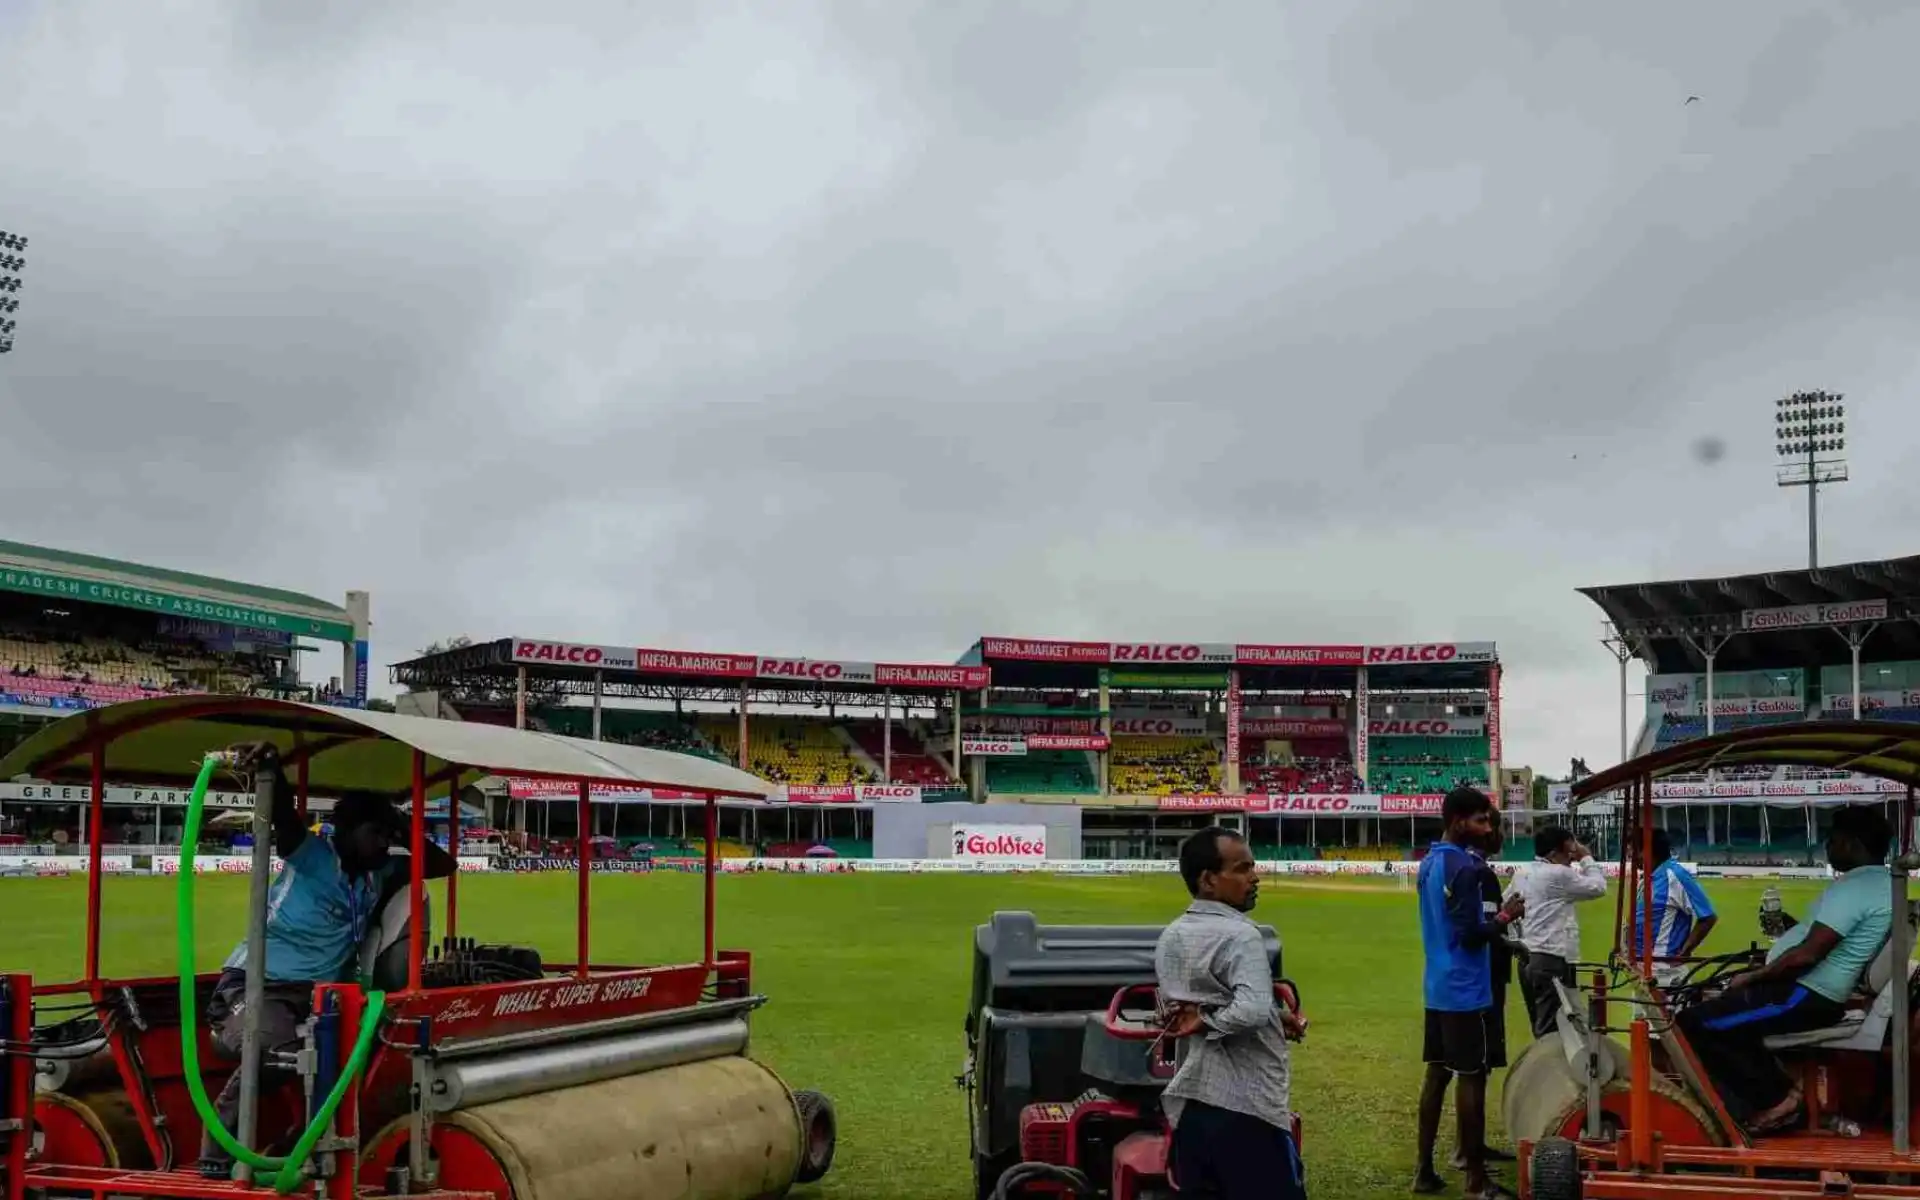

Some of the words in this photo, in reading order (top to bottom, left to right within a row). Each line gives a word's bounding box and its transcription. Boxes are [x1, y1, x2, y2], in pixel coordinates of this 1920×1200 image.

[0, 573, 79, 593] RADESH
[90, 584, 164, 608] CRICKET
[174, 598, 277, 625] ASSOCIATION
[516, 643, 604, 664] RALCO
[987, 641, 1070, 658] INFRA.MARKET
[1113, 645, 1200, 661] RALCO
[1237, 647, 1321, 662] INFRA.MARKET
[1366, 645, 1457, 663] RALCO
[640, 652, 732, 671] INFRA.MARKET
[760, 660, 842, 678] RALCO
[878, 667, 965, 684] INFRA.MARKET
[1367, 720, 1449, 735] RALCO
[862, 786, 915, 797] RALCO
[1272, 796, 1349, 811] RALCO
[966, 834, 1045, 855] Goldiee
[509, 859, 531, 870] RAJ
[537, 858, 580, 871] NIWAS
[492, 989, 547, 1016] WHALE
[550, 984, 598, 1008] SUPER
[601, 976, 653, 1001] SOPPER
